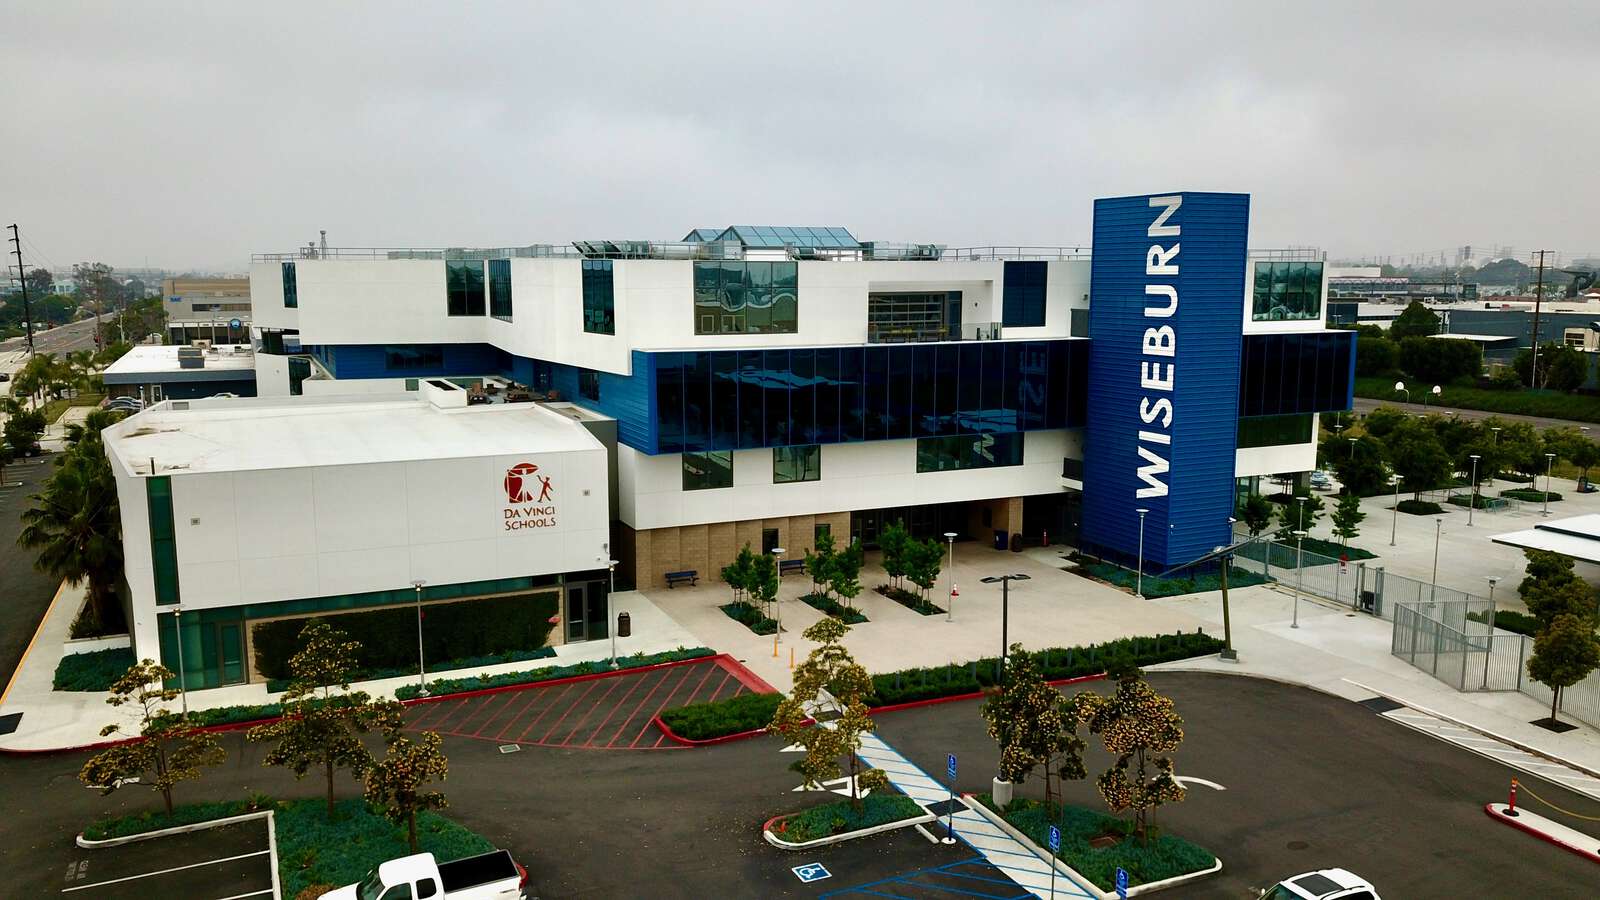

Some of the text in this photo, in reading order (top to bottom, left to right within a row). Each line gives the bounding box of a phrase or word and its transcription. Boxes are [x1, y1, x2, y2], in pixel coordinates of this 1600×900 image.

[1136, 195, 1182, 498] WISEBURN
[504, 506, 555, 518] DA VINCI
[505, 517, 556, 531] SCHOOLS
